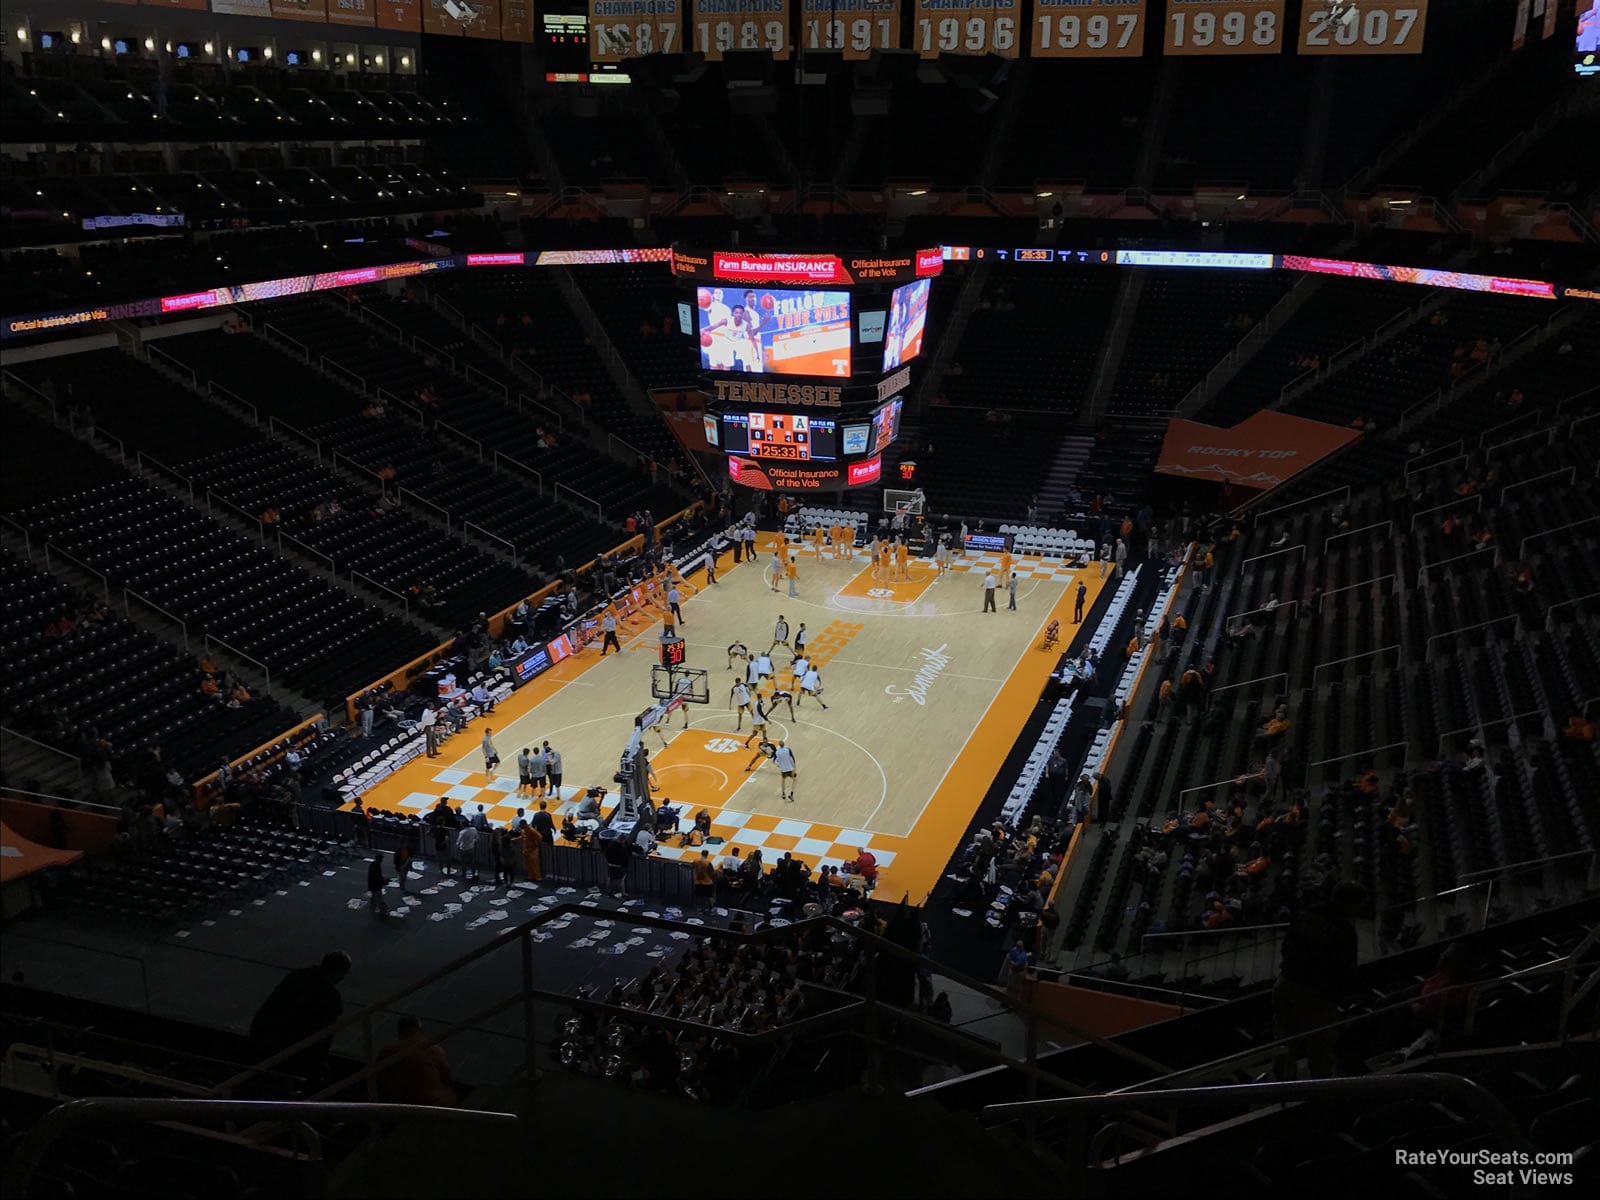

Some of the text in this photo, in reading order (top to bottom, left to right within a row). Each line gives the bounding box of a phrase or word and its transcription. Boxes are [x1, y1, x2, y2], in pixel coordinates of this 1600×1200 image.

[594, 0, 676, 15] CHAMPIONS
[698, 0, 784, 13] CHAMPIONS
[807, 19, 890, 51] 1991
[919, 17, 1015, 51] 1996
[1038, 14, 1137, 49] 1997
[1171, 11, 1277, 47] 1998
[1306, 9, 1418, 46] 2007
[698, 21, 784, 53] 1989
[719, 259, 835, 273] Farm Bureau INSURANCE
[851, 259, 911, 269] Official Insurance
[858, 268, 897, 278] of the Vols
[774, 293, 825, 316] FOLLOW
[777, 303, 848, 329] YOUR VOLS
[714, 380, 842, 407] TENNESSEE
[763, 445, 797, 457] 25:33
[1187, 446, 1297, 459] ROCKY TOP
[768, 467, 839, 479] Official Insurance
[902, 470, 912, 480] 30
[776, 478, 820, 488] of the Vols
[670, 649, 682, 664] 30
